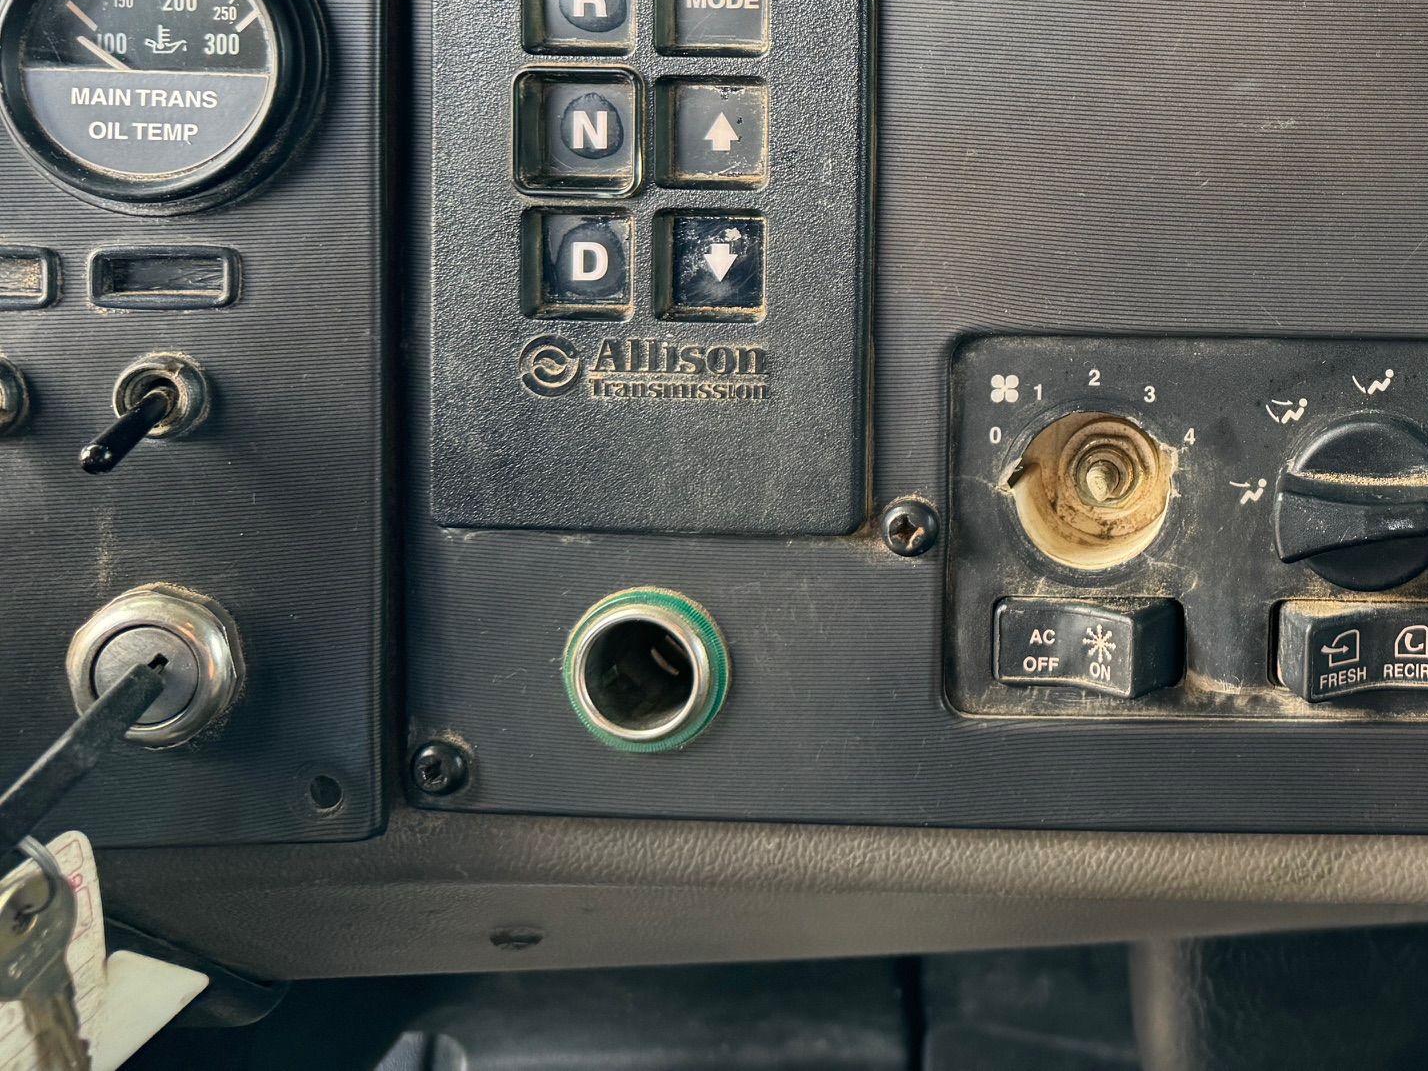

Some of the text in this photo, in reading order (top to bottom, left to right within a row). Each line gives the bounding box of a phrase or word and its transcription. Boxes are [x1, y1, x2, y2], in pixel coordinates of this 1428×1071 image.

[213, 6, 238, 22] 250
[204, 33, 240, 55] 300
[71, 88, 218, 109] MAIN TRANS
[89, 122, 199, 142] OIL TEMP
[573, 110, 608, 149] N
[572, 241, 609, 281] D
[588, 337, 770, 375] Allison
[1088, 370, 1100, 386] 2
[588, 378, 770, 400] Transmission
[1034, 385, 1043, 400] 1
[1144, 386, 1156, 402] 3
[989, 428, 1002, 444] 0
[1183, 428, 1195, 444] 4
[1029, 629, 1056, 645] AC
[1023, 656, 1059, 672] OFF
[1089, 662, 1111, 680] ON
[1320, 666, 1367, 689] FRESH
